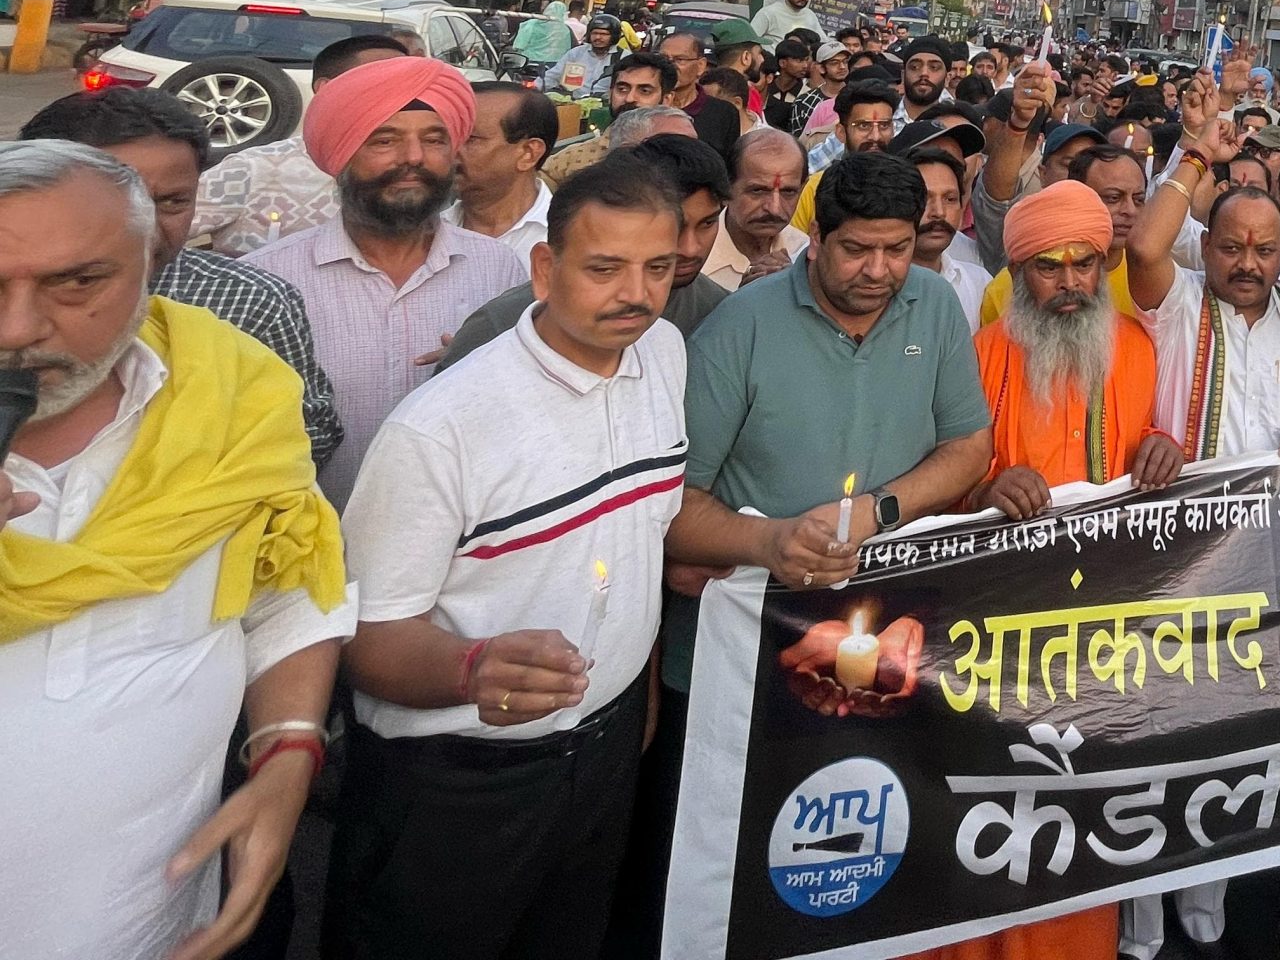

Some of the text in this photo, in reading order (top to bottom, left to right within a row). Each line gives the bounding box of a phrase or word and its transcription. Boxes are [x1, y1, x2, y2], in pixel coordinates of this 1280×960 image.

[1063, 506, 1122, 553] एवम
[1124, 499, 1180, 552] समूह
[1184, 478, 1272, 534] कार्यकर्ता
[939, 569, 1269, 713] आतंकवाद
[793, 783, 894, 856] ਆਪ
[786, 856, 886, 888] ਆਮ ਆਦਮੀ
[808, 881, 860, 908] ਪਾਰਟੀ
